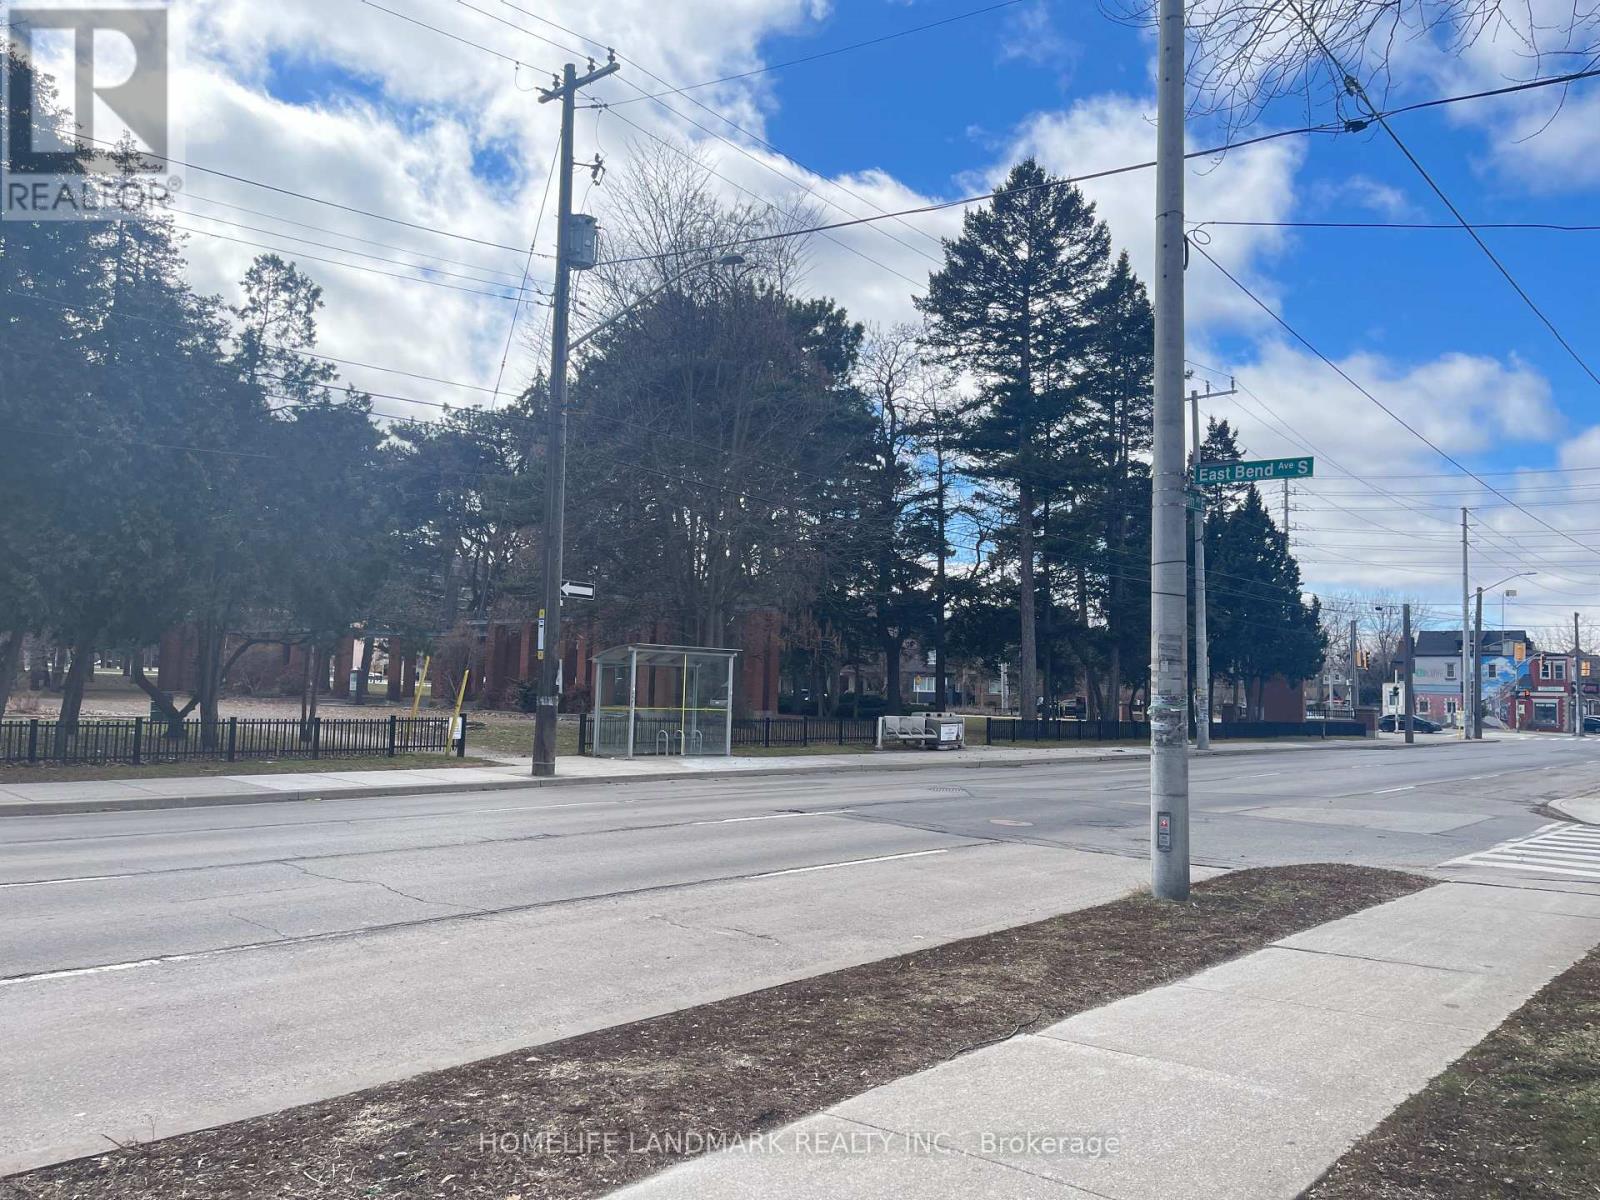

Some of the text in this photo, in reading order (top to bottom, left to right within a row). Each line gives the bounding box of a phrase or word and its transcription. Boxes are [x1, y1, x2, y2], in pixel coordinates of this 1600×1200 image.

[1199, 460, 1308, 481] East Bend Ave S
